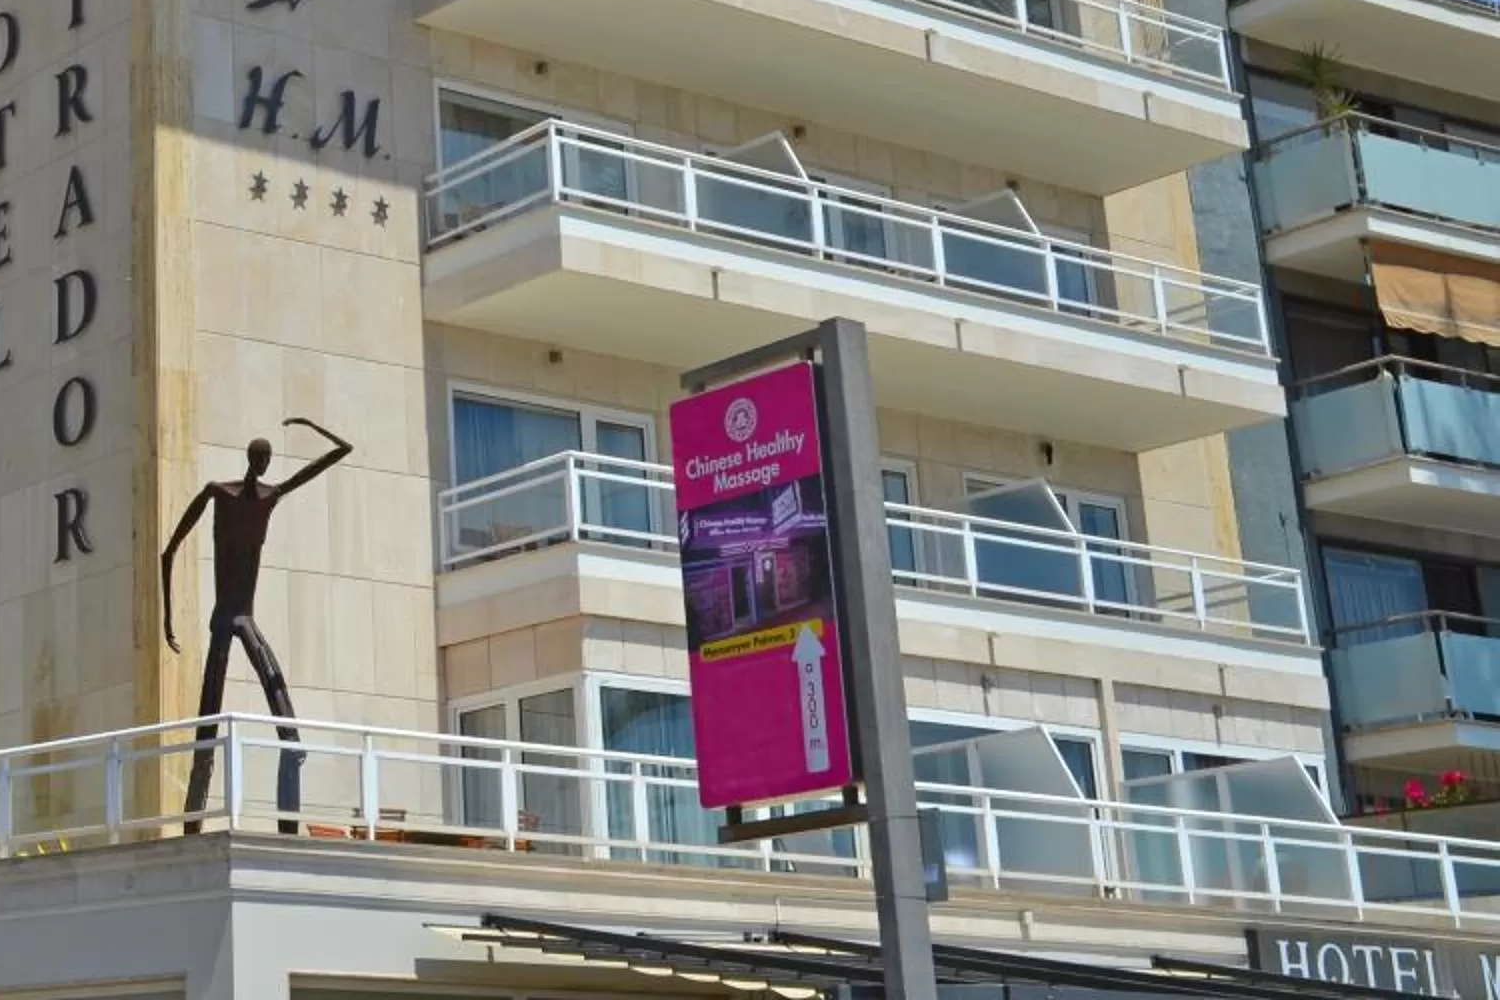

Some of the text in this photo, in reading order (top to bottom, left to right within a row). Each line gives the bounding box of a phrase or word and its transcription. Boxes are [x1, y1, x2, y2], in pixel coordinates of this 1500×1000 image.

[685, 429, 804, 479] Chinese Healthy
[713, 462, 780, 493] Massage
[1276, 940, 1460, 998] HOTEL
